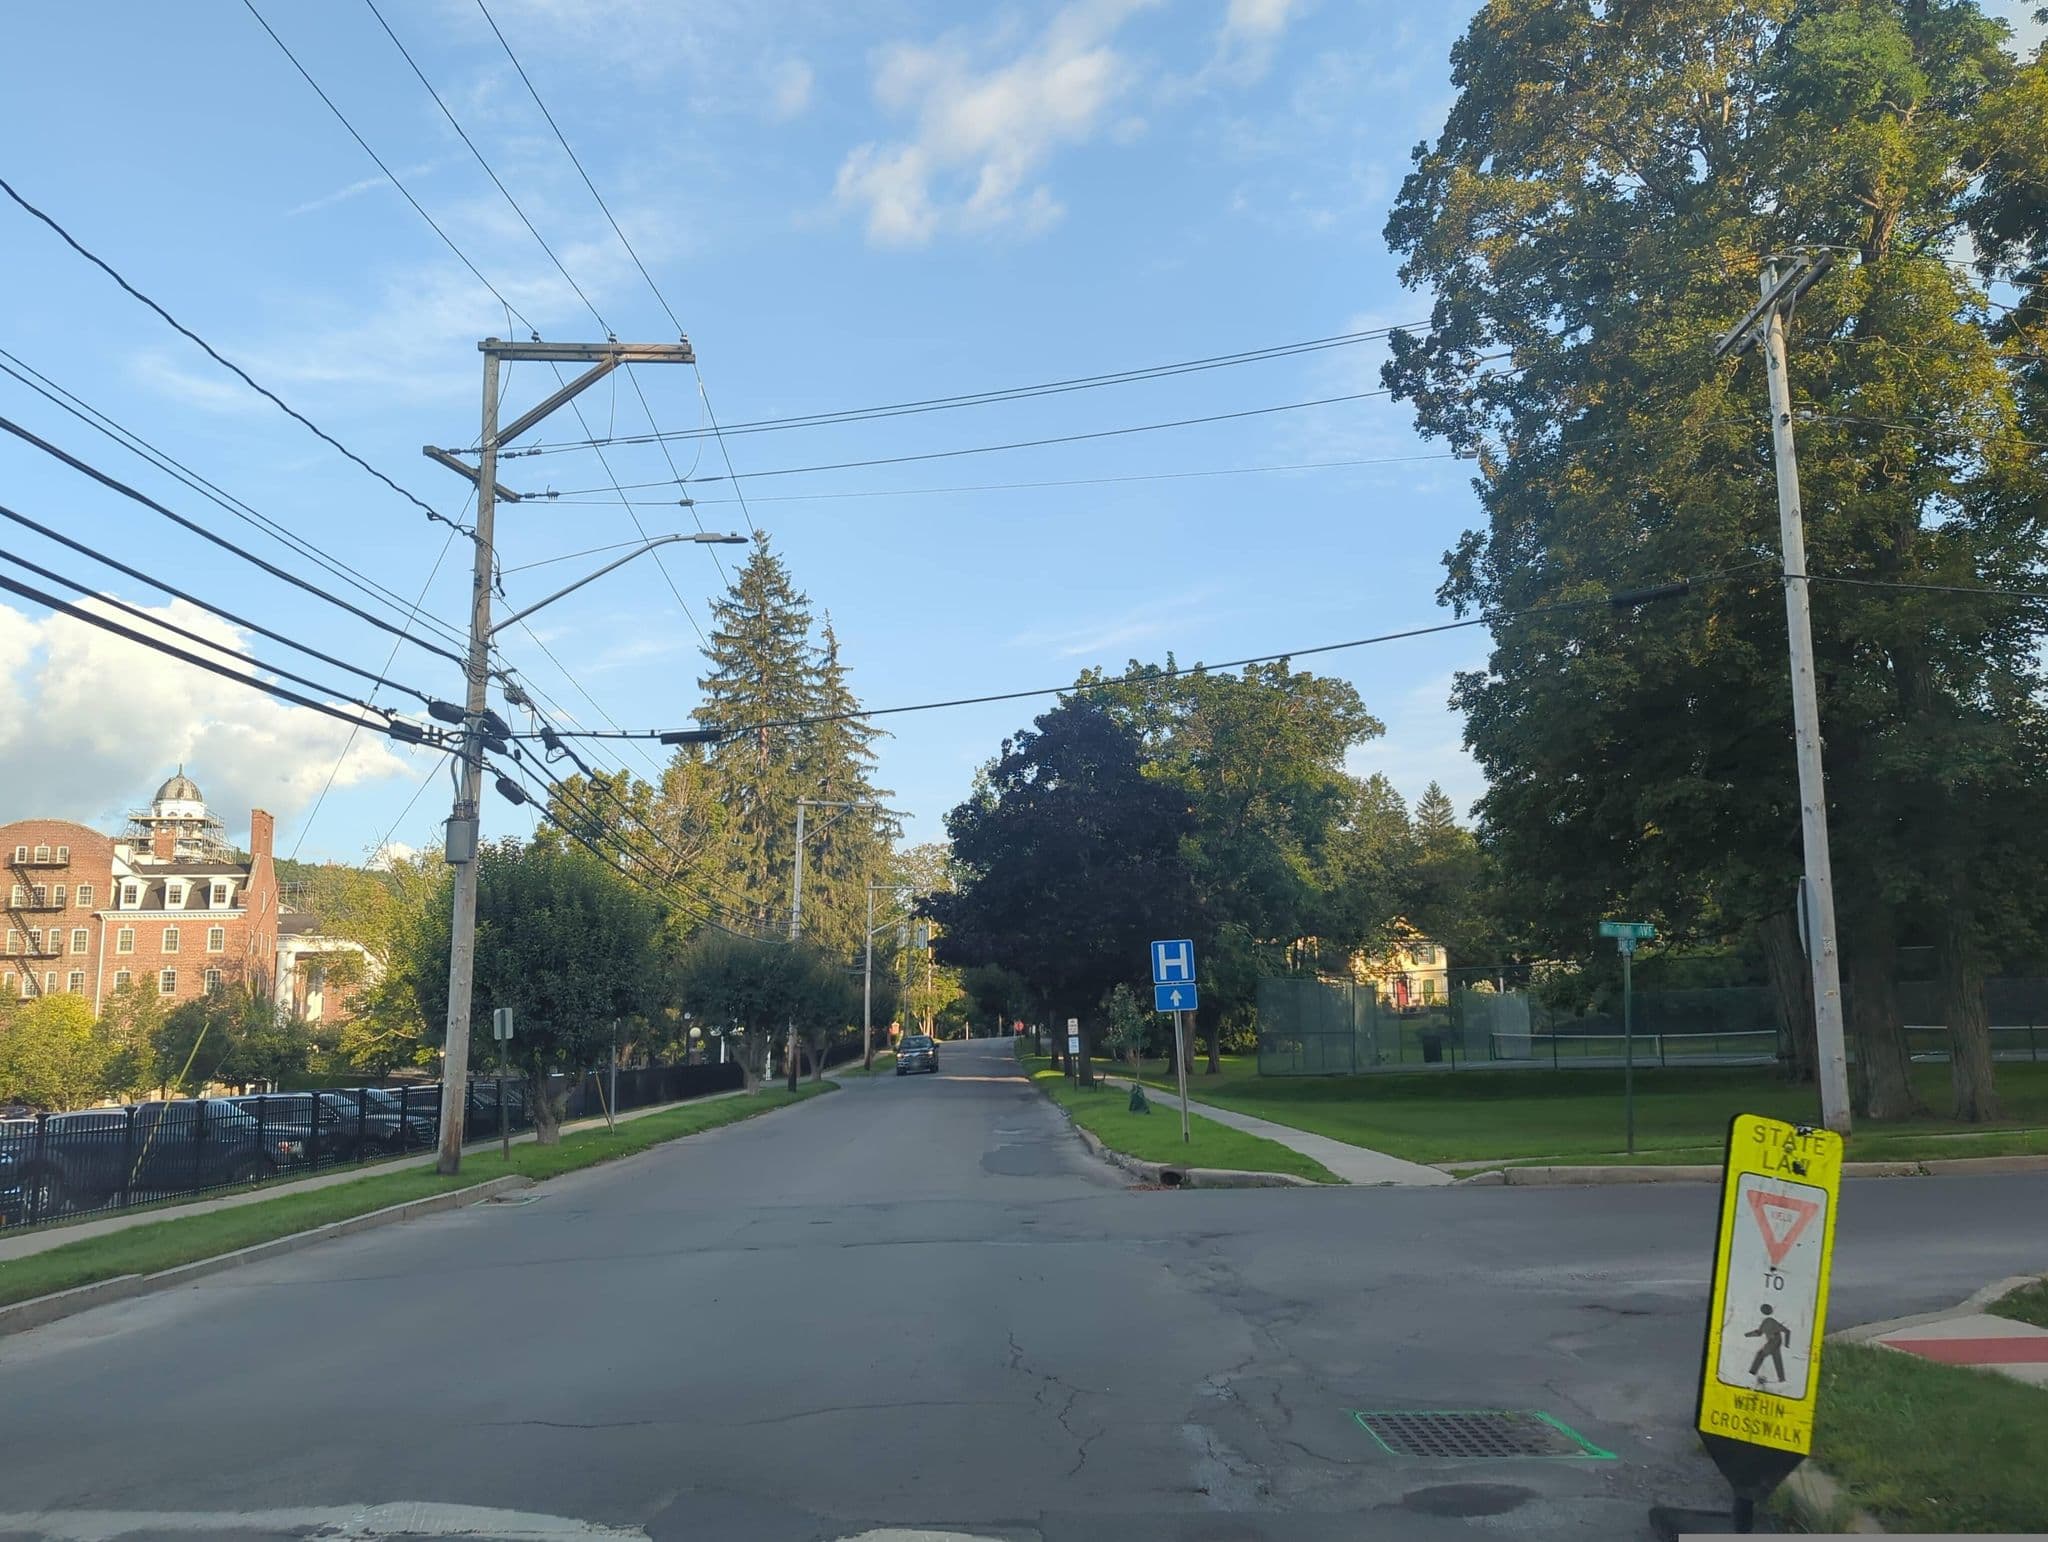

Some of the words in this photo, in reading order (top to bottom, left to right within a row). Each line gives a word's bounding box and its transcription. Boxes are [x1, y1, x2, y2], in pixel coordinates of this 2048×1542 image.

[1158, 943, 1189, 980] H
[1752, 1124, 1825, 1156] STATE
[1763, 1273, 1785, 1291] TO
[1733, 1394, 1785, 1418] WITHIN
[1710, 1410, 1802, 1444] CROSSWALK
